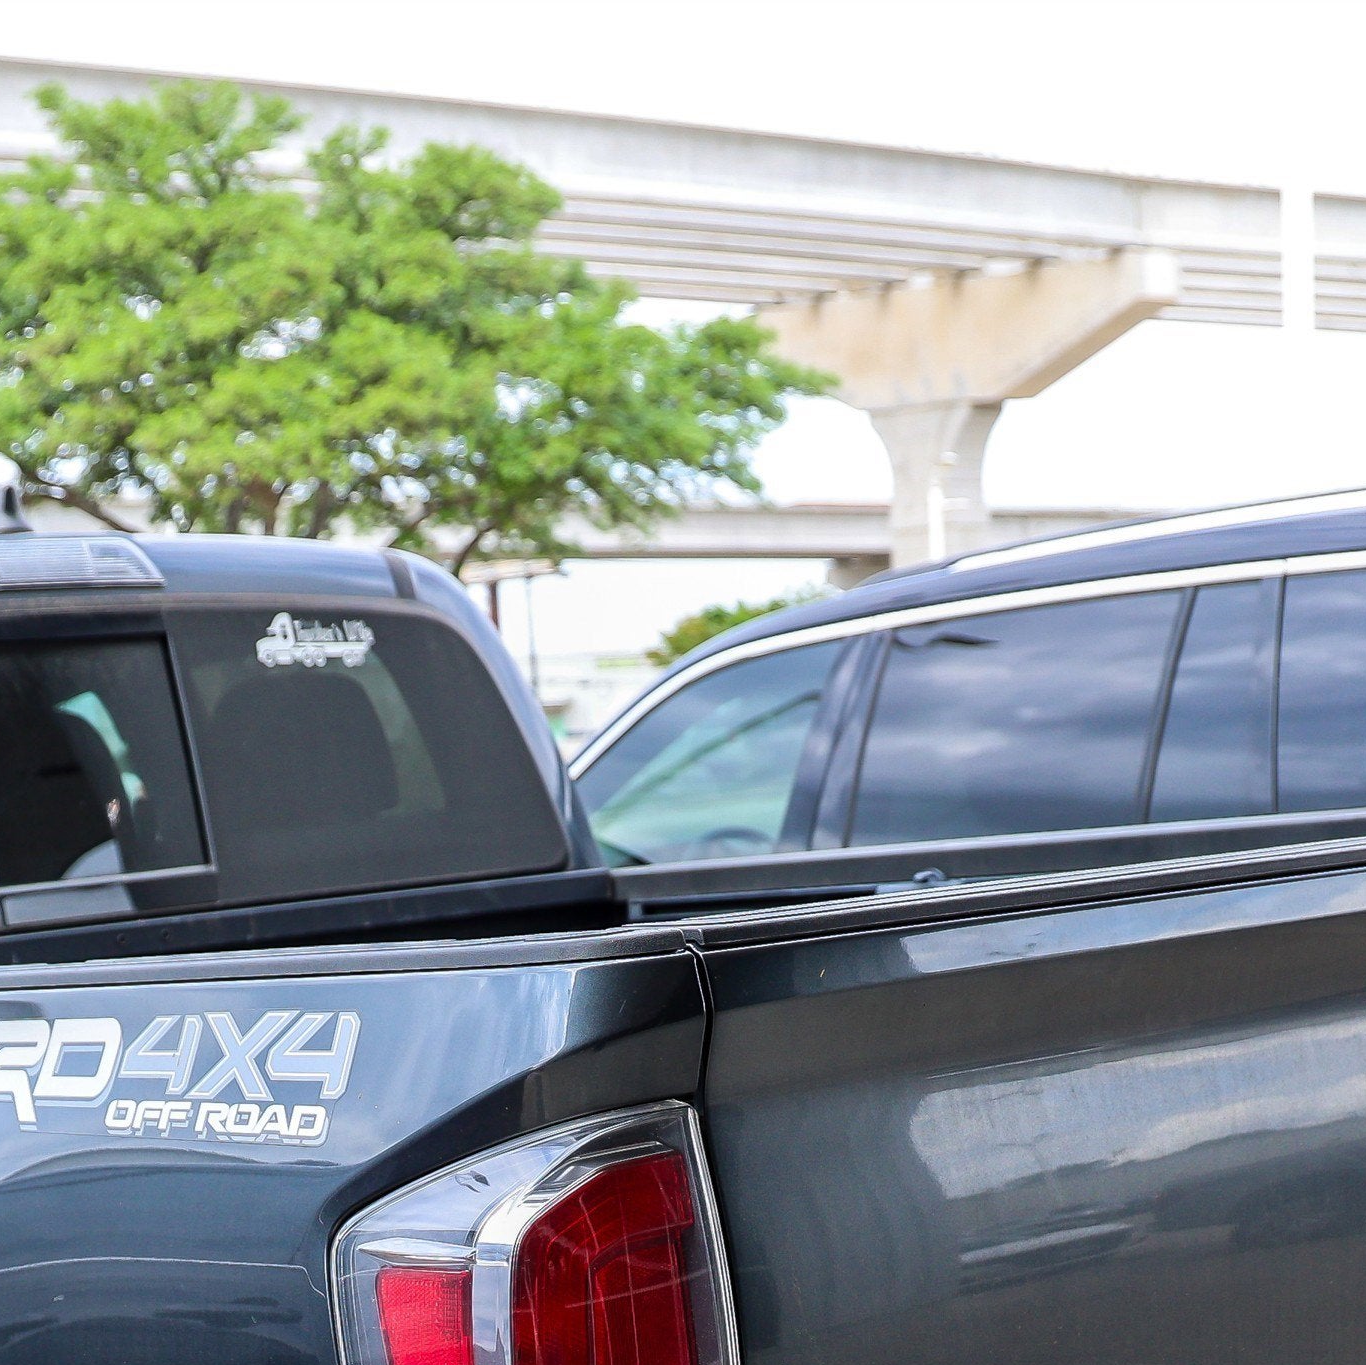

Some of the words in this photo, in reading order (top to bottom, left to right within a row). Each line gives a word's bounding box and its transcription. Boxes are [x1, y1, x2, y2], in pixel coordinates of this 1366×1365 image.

[117, 1009, 362, 1102] 4X4
[104, 1099, 193, 1137] OFF
[193, 1103, 329, 1147] ROAD
